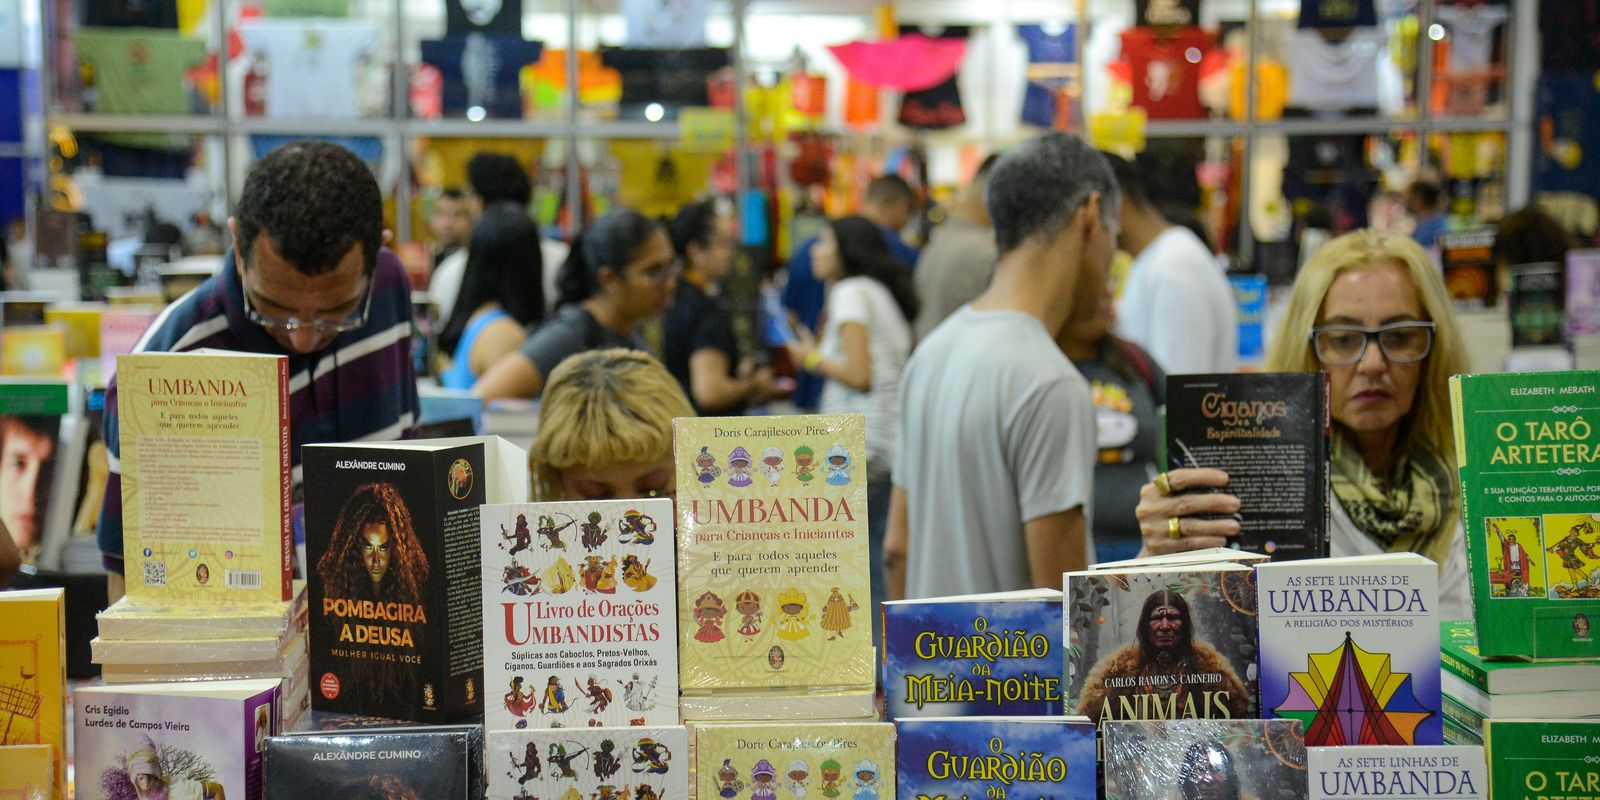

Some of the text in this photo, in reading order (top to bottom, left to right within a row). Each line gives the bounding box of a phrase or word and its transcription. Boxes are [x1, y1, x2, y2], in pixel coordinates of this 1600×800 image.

[148, 378, 248, 396] UMBANDA
[1510, 386, 1595, 396] ELIZABETH MERATH
[170, 400, 202, 408] Crianças
[210, 400, 248, 408] Iniciantes
[1202, 392, 1288, 426] Ciganos
[212, 412, 238, 422] aqueles
[207, 421, 240, 430] aprender
[1496, 416, 1591, 442] O TARÔ
[714, 426, 829, 439] Doris Carajilescov Pires
[1206, 428, 1281, 442] Espiritualidade
[1490, 444, 1600, 465] ARTETERA
[336, 459, 406, 471] ALEXÂNDRE CUMINO
[1507, 486, 1537, 495] FUNÇÃO
[692, 497, 856, 525] UMBANDA
[1462, 480, 1471, 549] ARTETERAPIA
[695, 529, 854, 544] para Crianças e Iniciantes
[713, 550, 837, 563] E para todos aqueles
[711, 564, 839, 577] que querem aprender
[1286, 576, 1409, 586] AS SETE LINHAS DE
[1268, 588, 1428, 613] UMBANDA
[323, 598, 427, 624] POMBAGIRA
[536, 599, 659, 622] Livro de Orações
[501, 602, 660, 646] UMBANDISTAS
[974, 617, 987, 632] O
[1293, 618, 1338, 628] RELIGIÃO
[1363, 618, 1414, 627] MISTÉRIOS
[340, 624, 414, 647] A DEUSA
[332, 649, 367, 659] MULHER
[371, 652, 396, 662] IGUAL
[511, 651, 543, 661] Súplicas
[559, 650, 595, 659] Caboclos,
[597, 649, 650, 658] Pretos-Velhos,
[504, 662, 536, 672] Ciganos,
[537, 661, 574, 669] Guardiões
[597, 660, 632, 669] Sagrados
[633, 659, 657, 667] Orixás
[1105, 673, 1222, 688] CARLOS RAMON S. CARNEIRO
[85, 705, 130, 717] Cris Egídio
[1096, 690, 1231, 732] ANIMAIS
[85, 718, 190, 731] Lurdes de Campos Vieira
[737, 739, 764, 749] Doris
[989, 738, 1002, 753] O
[1542, 735, 1587, 743] ELIZABETH
[313, 750, 421, 761] ALEXÂNDRE CUMINO
[1338, 757, 1459, 768] AS SETE LINHAS DE
[1320, 771, 1478, 796] UMBANDA
[1525, 771, 1600, 792] O TAR
